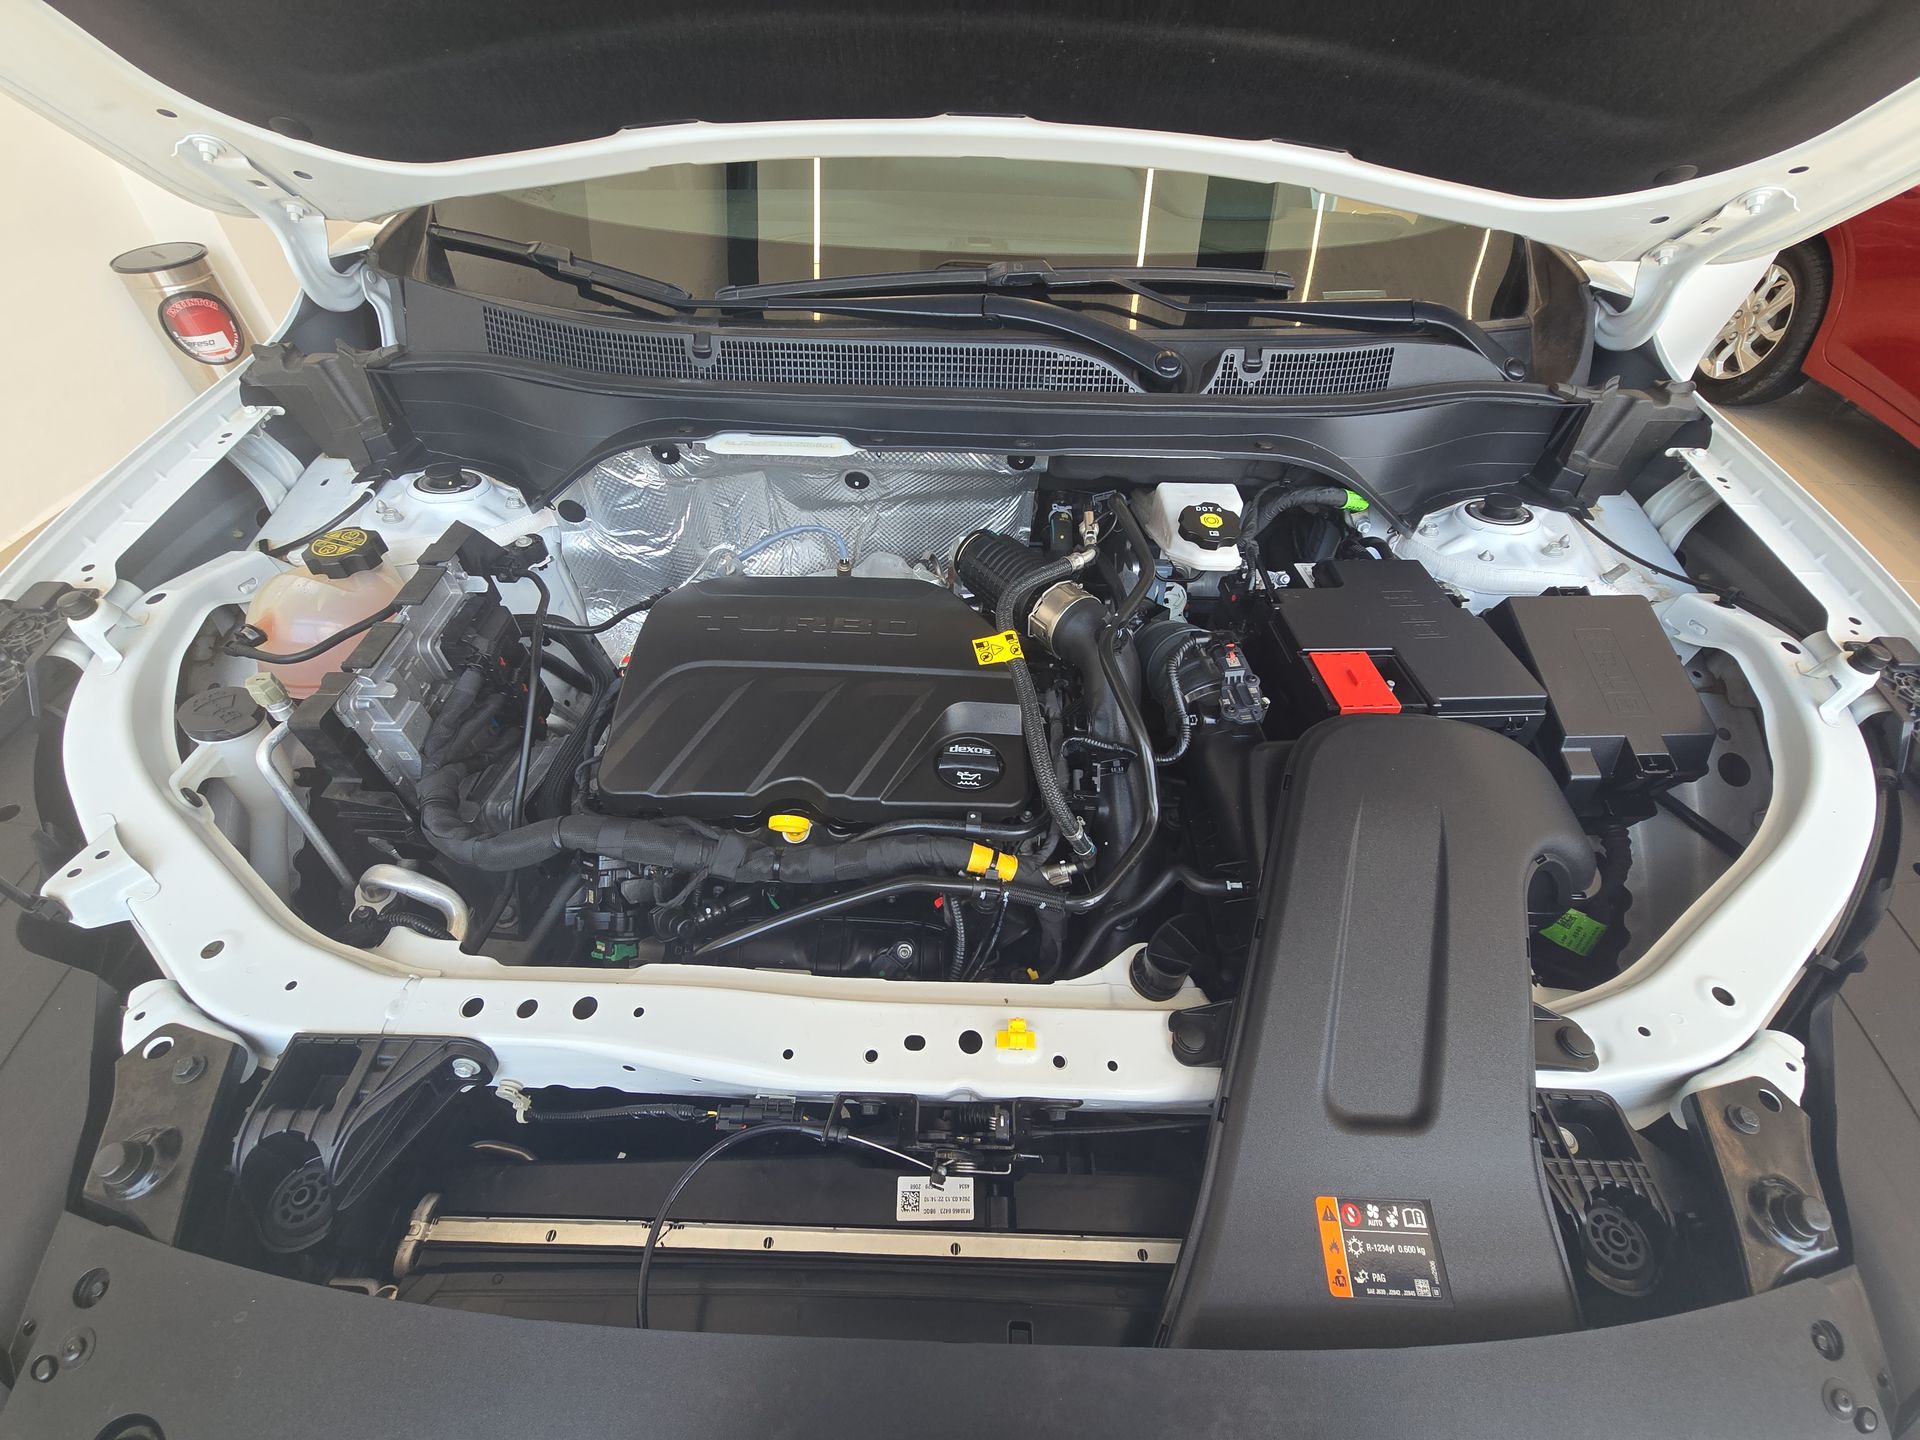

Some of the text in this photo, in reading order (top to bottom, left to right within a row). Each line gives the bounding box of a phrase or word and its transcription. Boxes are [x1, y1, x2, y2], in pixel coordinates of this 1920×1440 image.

[697, 614, 918, 637] TURBO
[949, 744, 992, 755] dexos
[1367, 1219, 1383, 1227] AUTO
[1366, 1243, 1426, 1256] R-1234yf 0.600 kg
[1371, 1272, 1387, 1283] PAG
